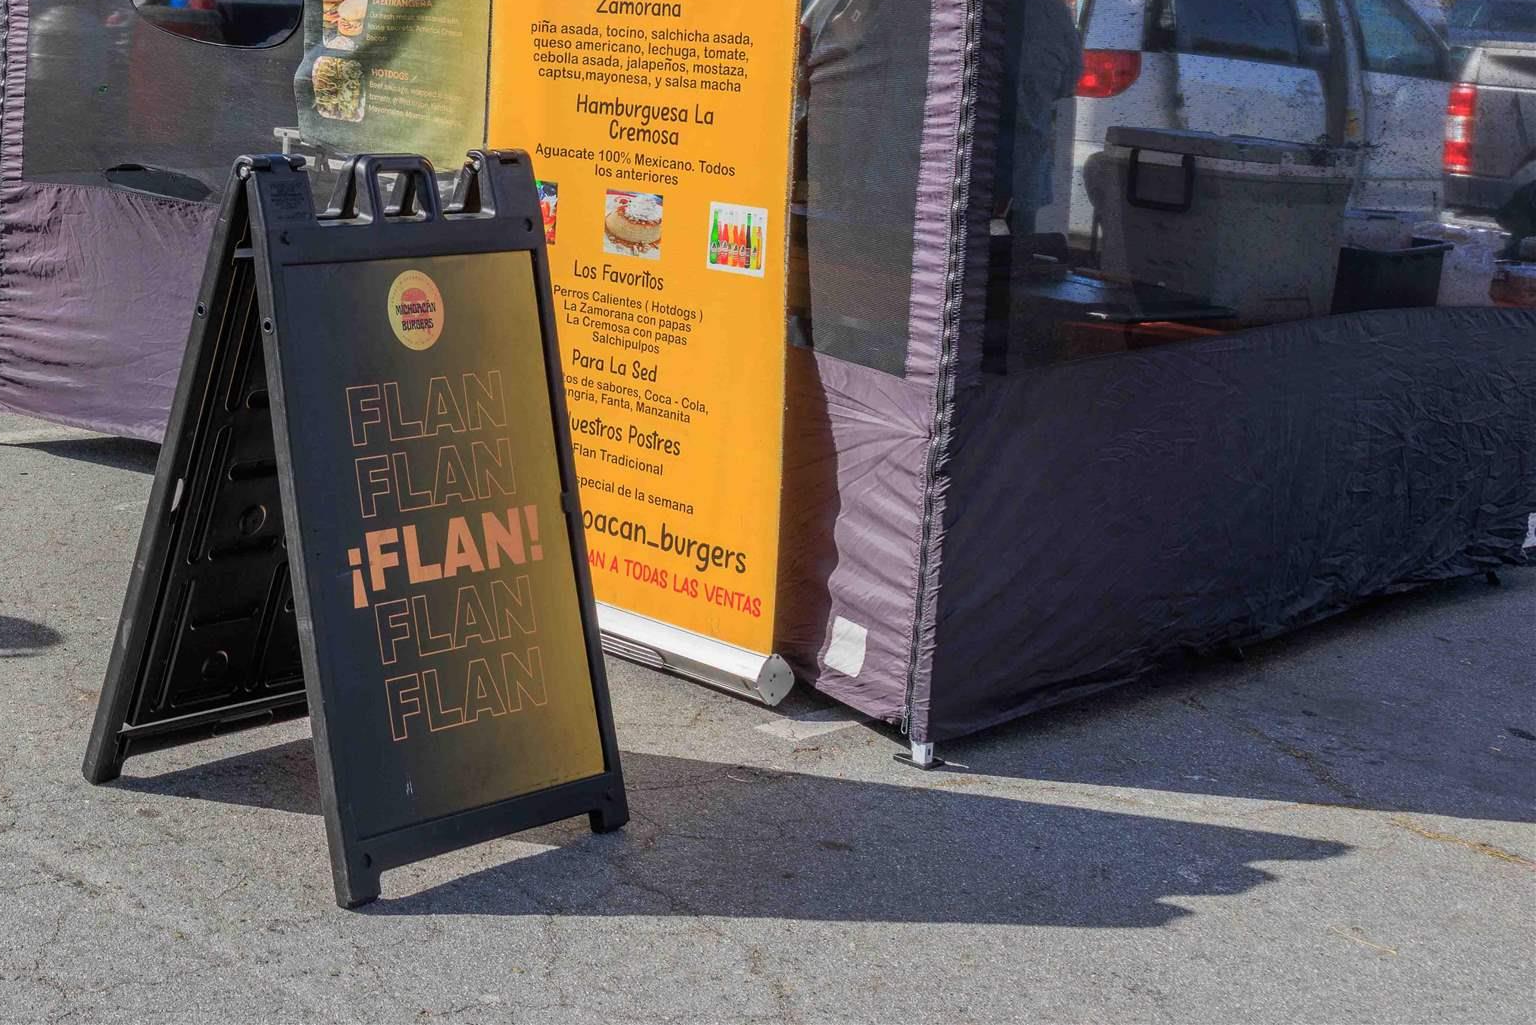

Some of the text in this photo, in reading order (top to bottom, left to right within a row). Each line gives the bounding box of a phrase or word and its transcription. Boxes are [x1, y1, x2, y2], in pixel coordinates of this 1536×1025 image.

[530, 20, 754, 46] piña asada, tocino, salchicha asada,
[533, 38, 750, 62] queso americano, lechuga, tomate,
[533, 52, 748, 79] cebolla asada, jalapeños, mostaza,
[371, 68, 409, 81] HOTDOGS
[654, 77, 662, 88] y
[664, 75, 697, 89] salsa
[700, 78, 742, 93] macha
[576, 93, 715, 125] Hamburguesa La
[609, 119, 679, 145] Cremosa
[535, 144, 736, 177] Aguacate 100% Mexicano. Todos
[594, 164, 679, 185] los anteriores
[574, 260, 664, 291] Los Favoritos
[553, 284, 590, 301] Perros
[592, 291, 642, 309] Calientes
[651, 301, 697, 320] Hotdogs
[563, 300, 692, 333] La Zamorana con papas
[401, 318, 434, 331] BURGERS
[566, 313, 688, 346] La Cremosa con papas
[592, 331, 660, 354] Salchipulpos
[572, 349, 658, 383] Para La Sed
[346, 370, 508, 447] FLAN
[567, 388, 691, 424] ngria, Fanta, Manzanita
[581, 376, 594, 388] de
[597, 380, 642, 399] sabores,
[644, 389, 672, 406] Coca
[681, 397, 709, 416] Cola,
[569, 411, 681, 456] uestros Postres
[573, 442, 664, 476] Flan Tradicional
[355, 437, 517, 519] FLAN
[576, 476, 694, 515] pecial de la semana
[348, 504, 544, 609] ¡FLAN!
[583, 509, 747, 574] oacan_burgers
[588, 548, 762, 618] AN A TODAS LAS VENTAS
[375, 575, 538, 665] FLAN
[385, 645, 548, 742] FLAN
